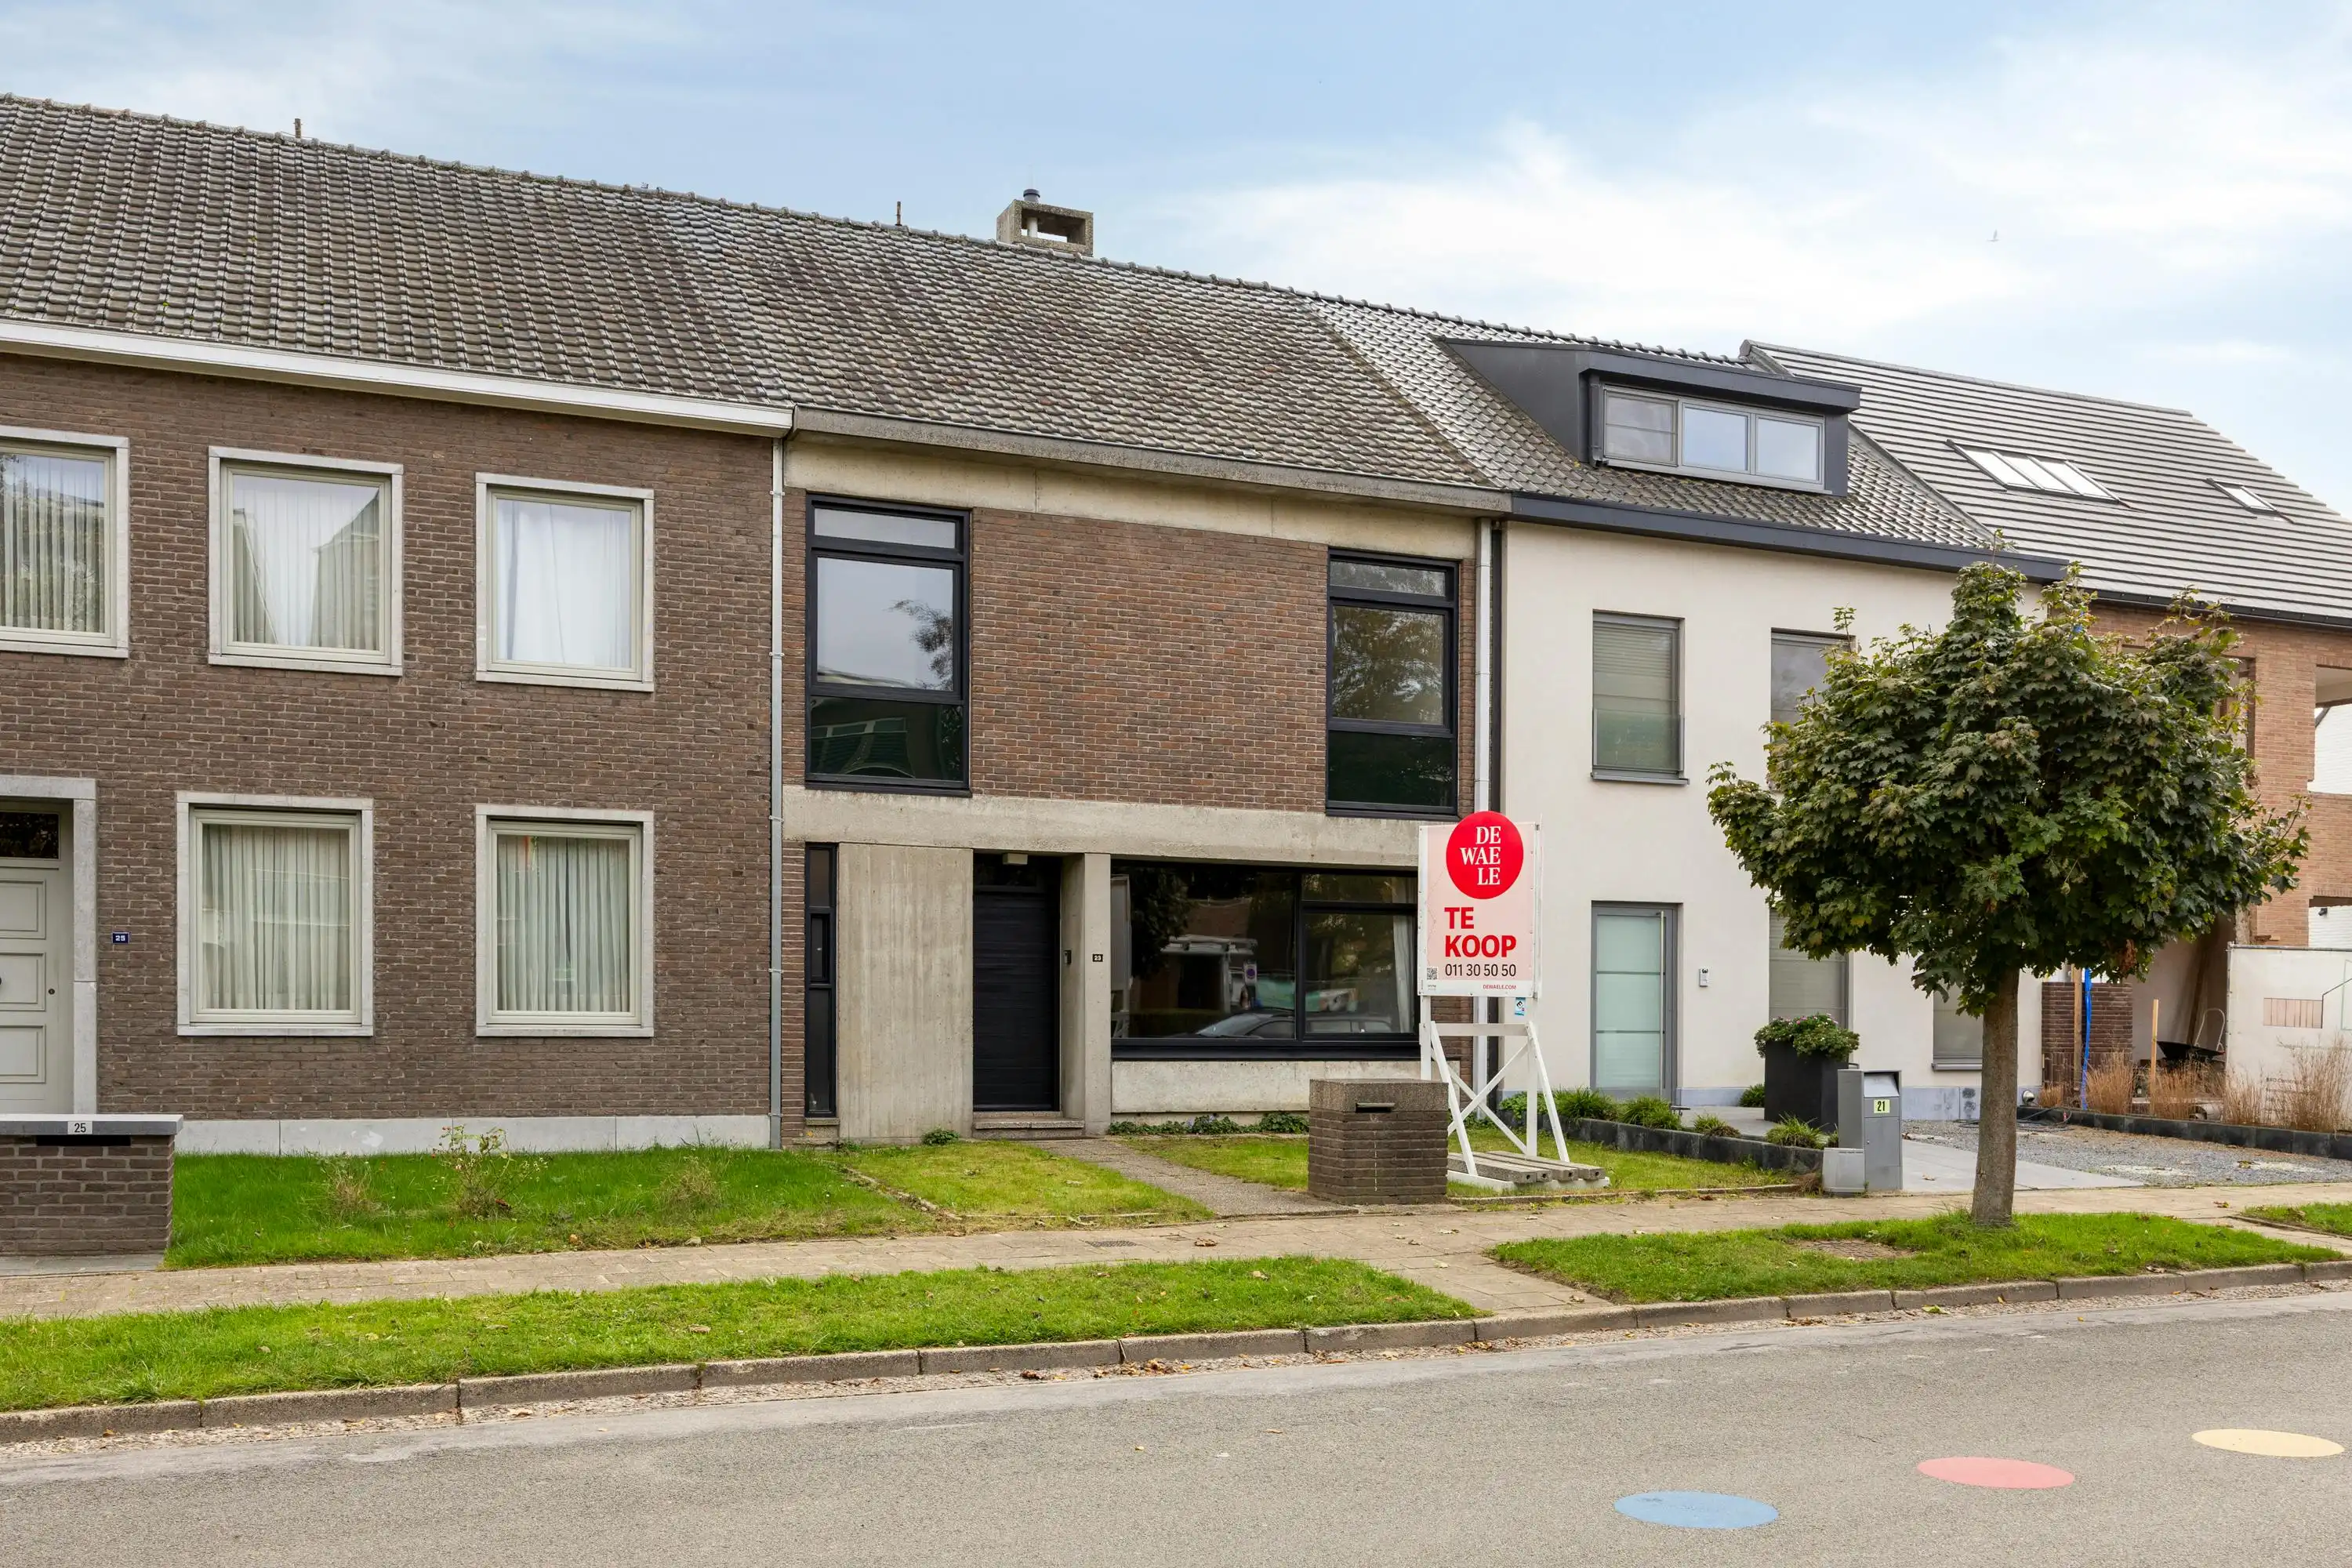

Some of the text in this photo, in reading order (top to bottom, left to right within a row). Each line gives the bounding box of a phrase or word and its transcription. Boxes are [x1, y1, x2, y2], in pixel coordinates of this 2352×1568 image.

[1475, 826, 1501, 844] DE
[1460, 846, 1501, 866] WAE
[1477, 867, 1501, 886] LE
[1444, 907, 1475, 929] TE
[1445, 935, 1517, 958] KOOP
[1445, 964, 1516, 977] 011 30 50 50
[1877, 1100, 1886, 1112] 21
[74, 1123, 86, 1133] 25
